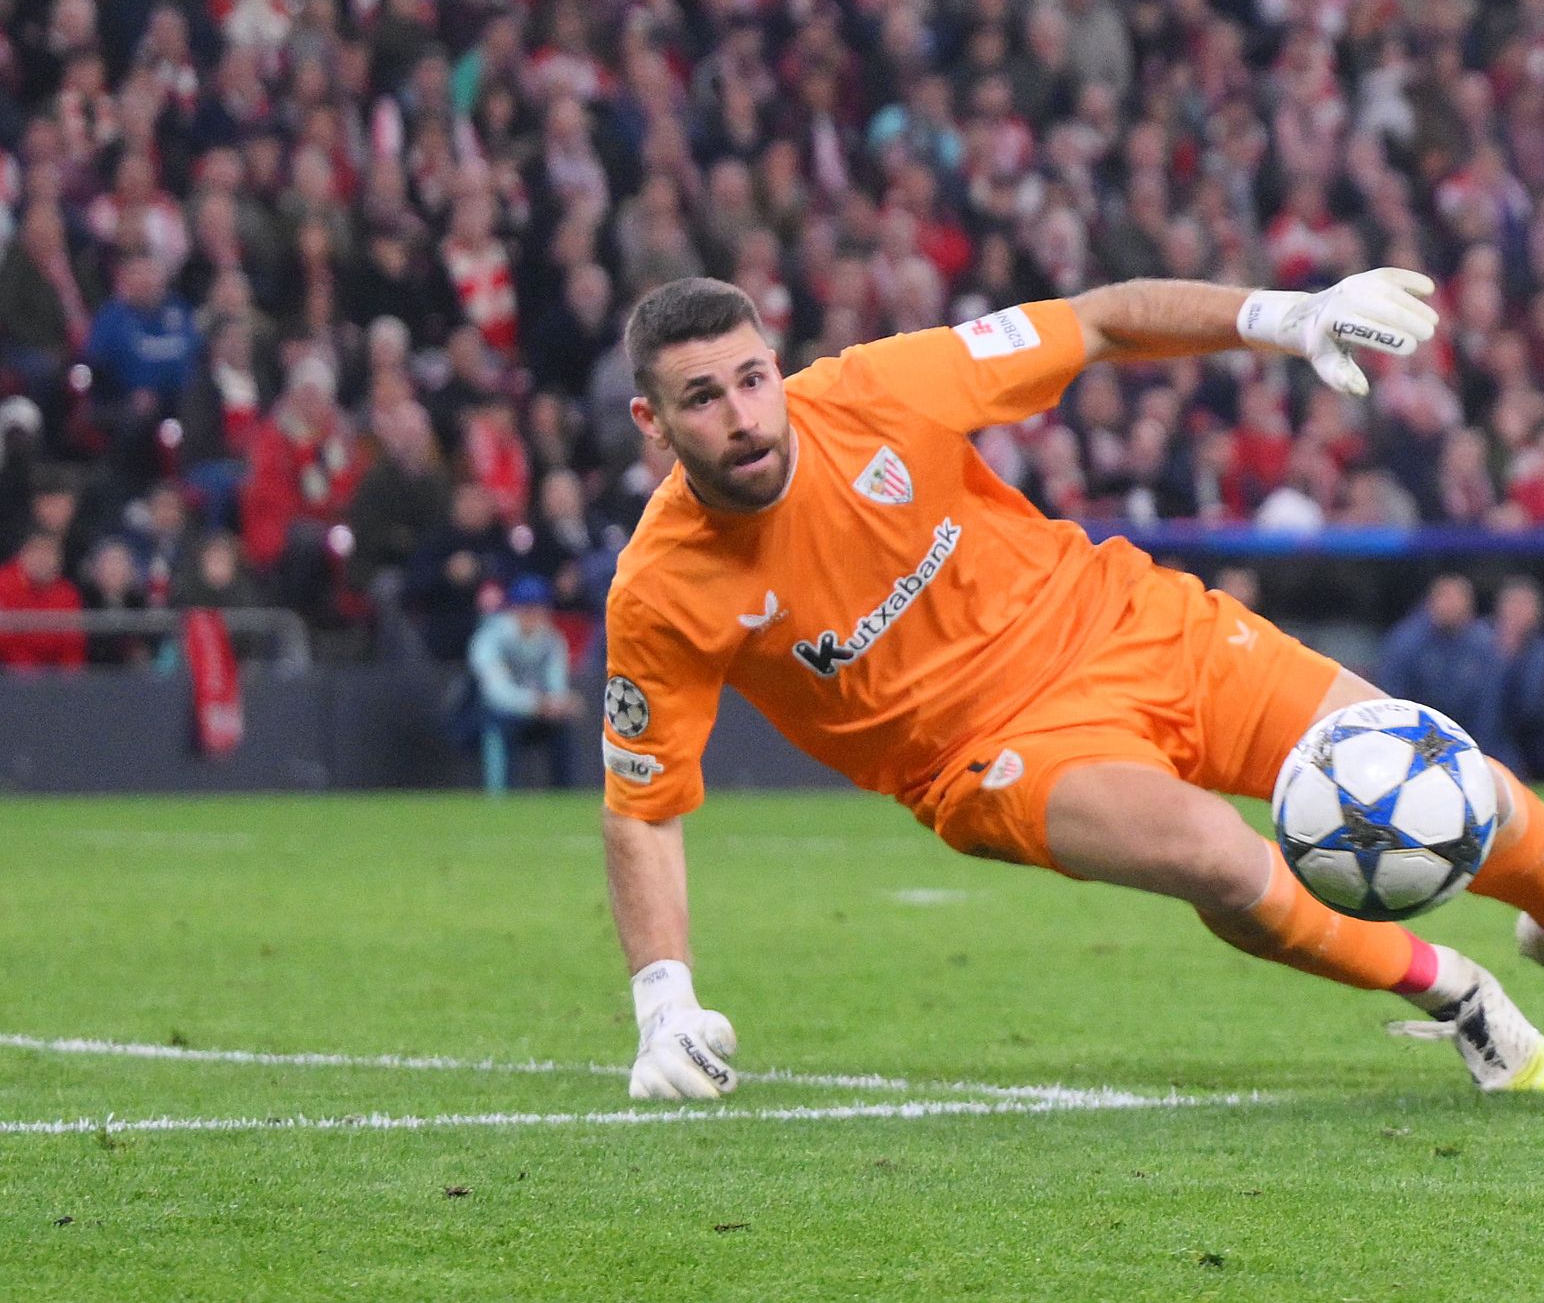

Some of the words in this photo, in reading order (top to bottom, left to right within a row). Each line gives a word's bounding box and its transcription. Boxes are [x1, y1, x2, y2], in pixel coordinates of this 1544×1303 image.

[1333, 319, 1406, 348] reusch
[796, 522, 958, 675] Kutxabank
[674, 1032, 730, 1086] reusch
